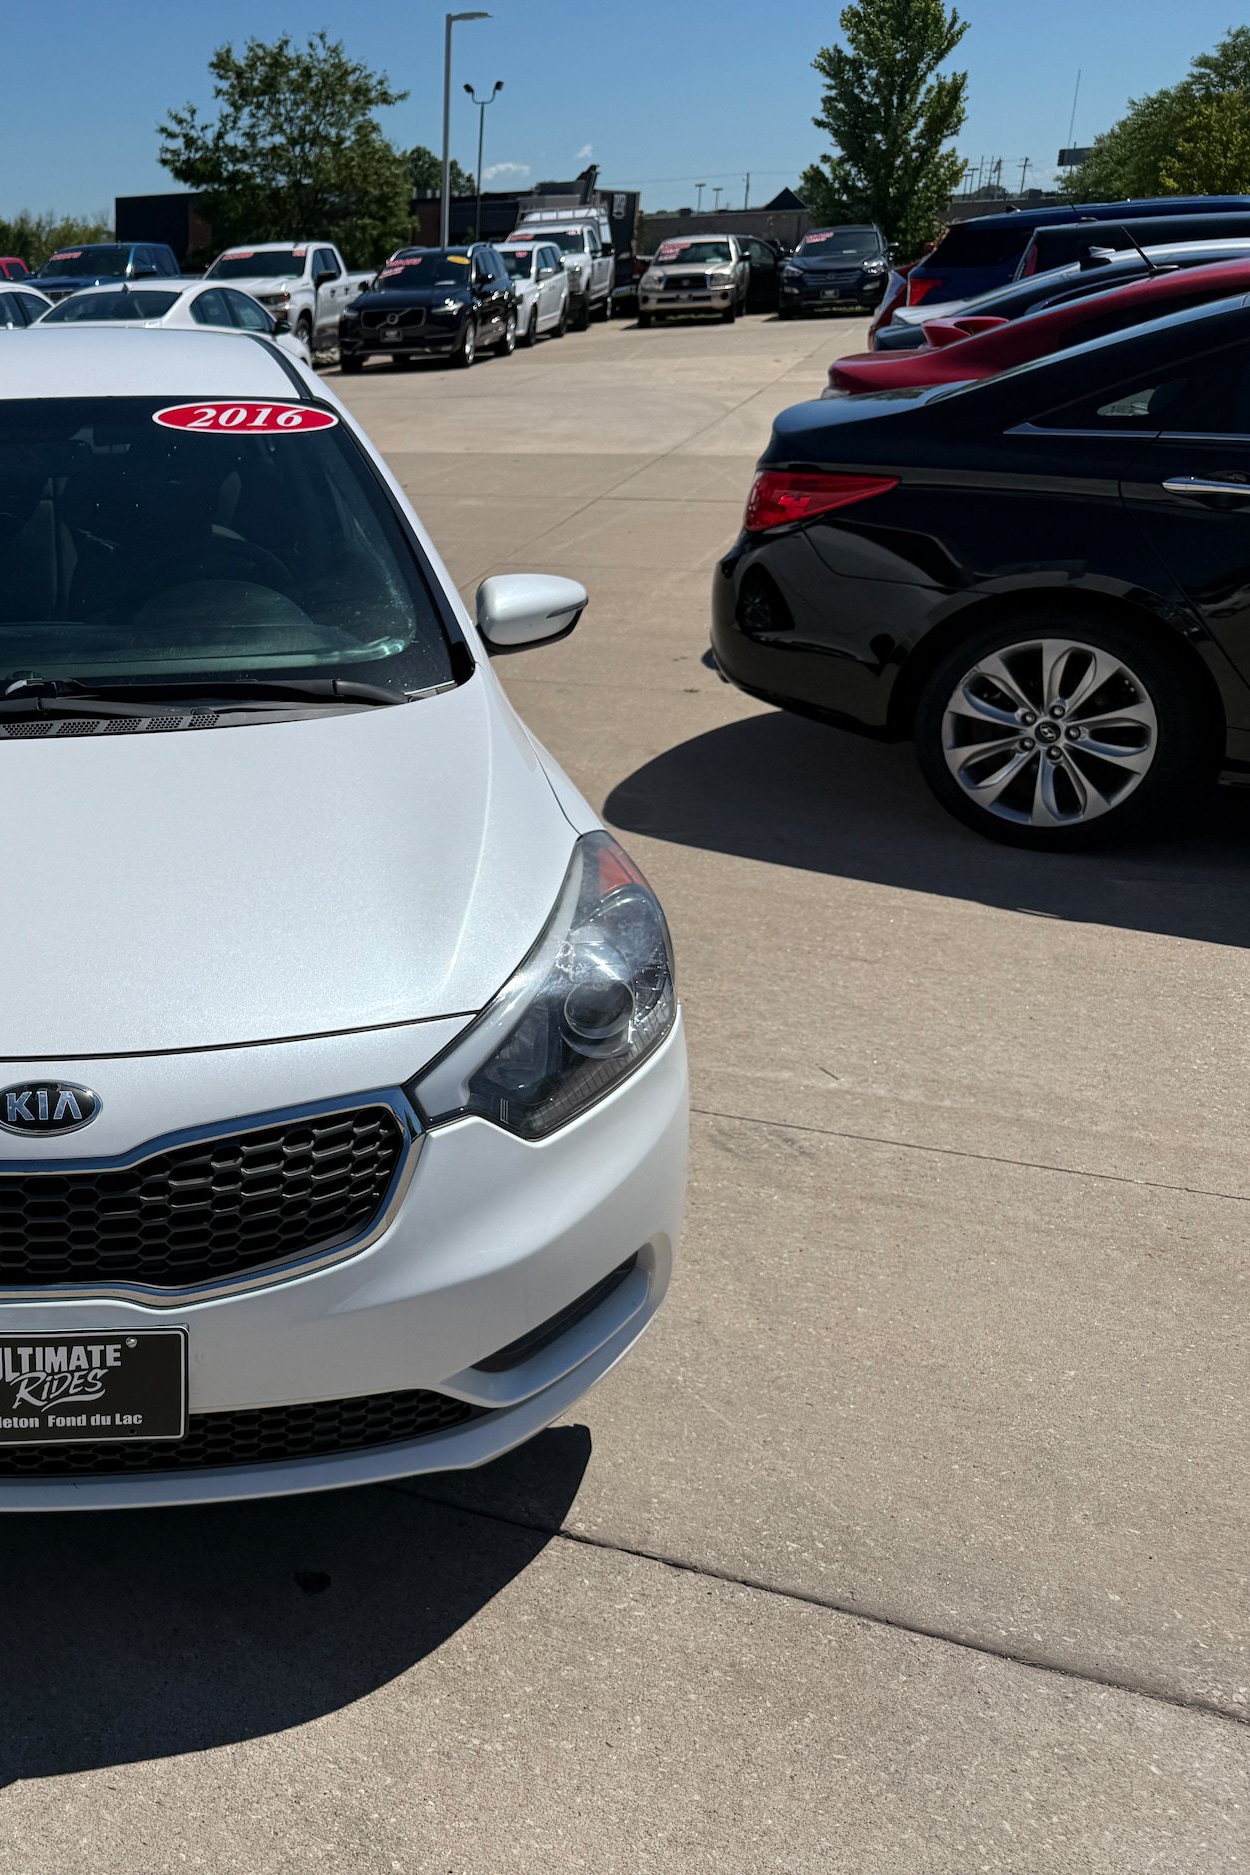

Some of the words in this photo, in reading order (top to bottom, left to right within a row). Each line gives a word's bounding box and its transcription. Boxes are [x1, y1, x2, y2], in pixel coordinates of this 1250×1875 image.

[186, 407, 306, 428] 2016
[6, 1090, 82, 1121] KIA
[47, 1414, 86, 1428] Fond
[90, 1413, 111, 1427] du
[115, 1412, 143, 1426] Lac
